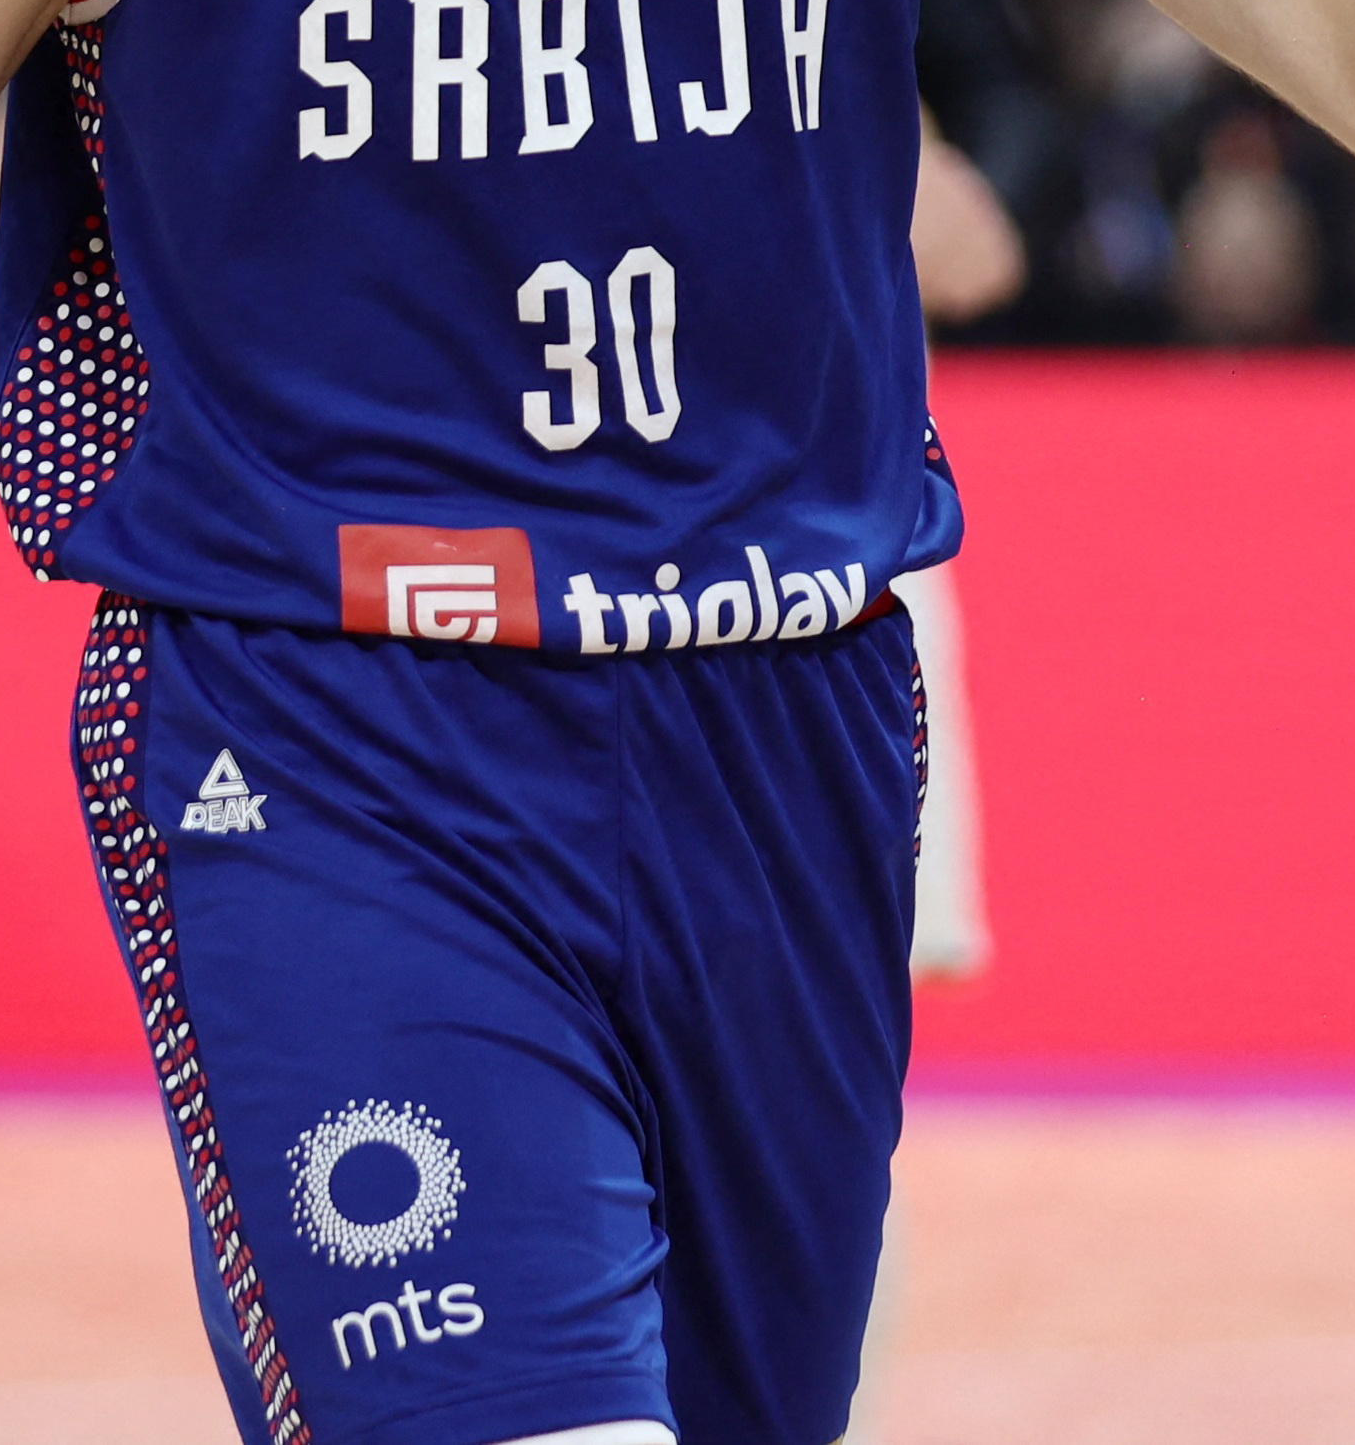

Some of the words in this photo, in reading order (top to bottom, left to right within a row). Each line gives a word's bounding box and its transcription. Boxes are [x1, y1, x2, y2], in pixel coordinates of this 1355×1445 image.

[516, 245, 682, 452] 30
[179, 794, 268, 834] PEAK
[331, 1279, 486, 1369] mts
